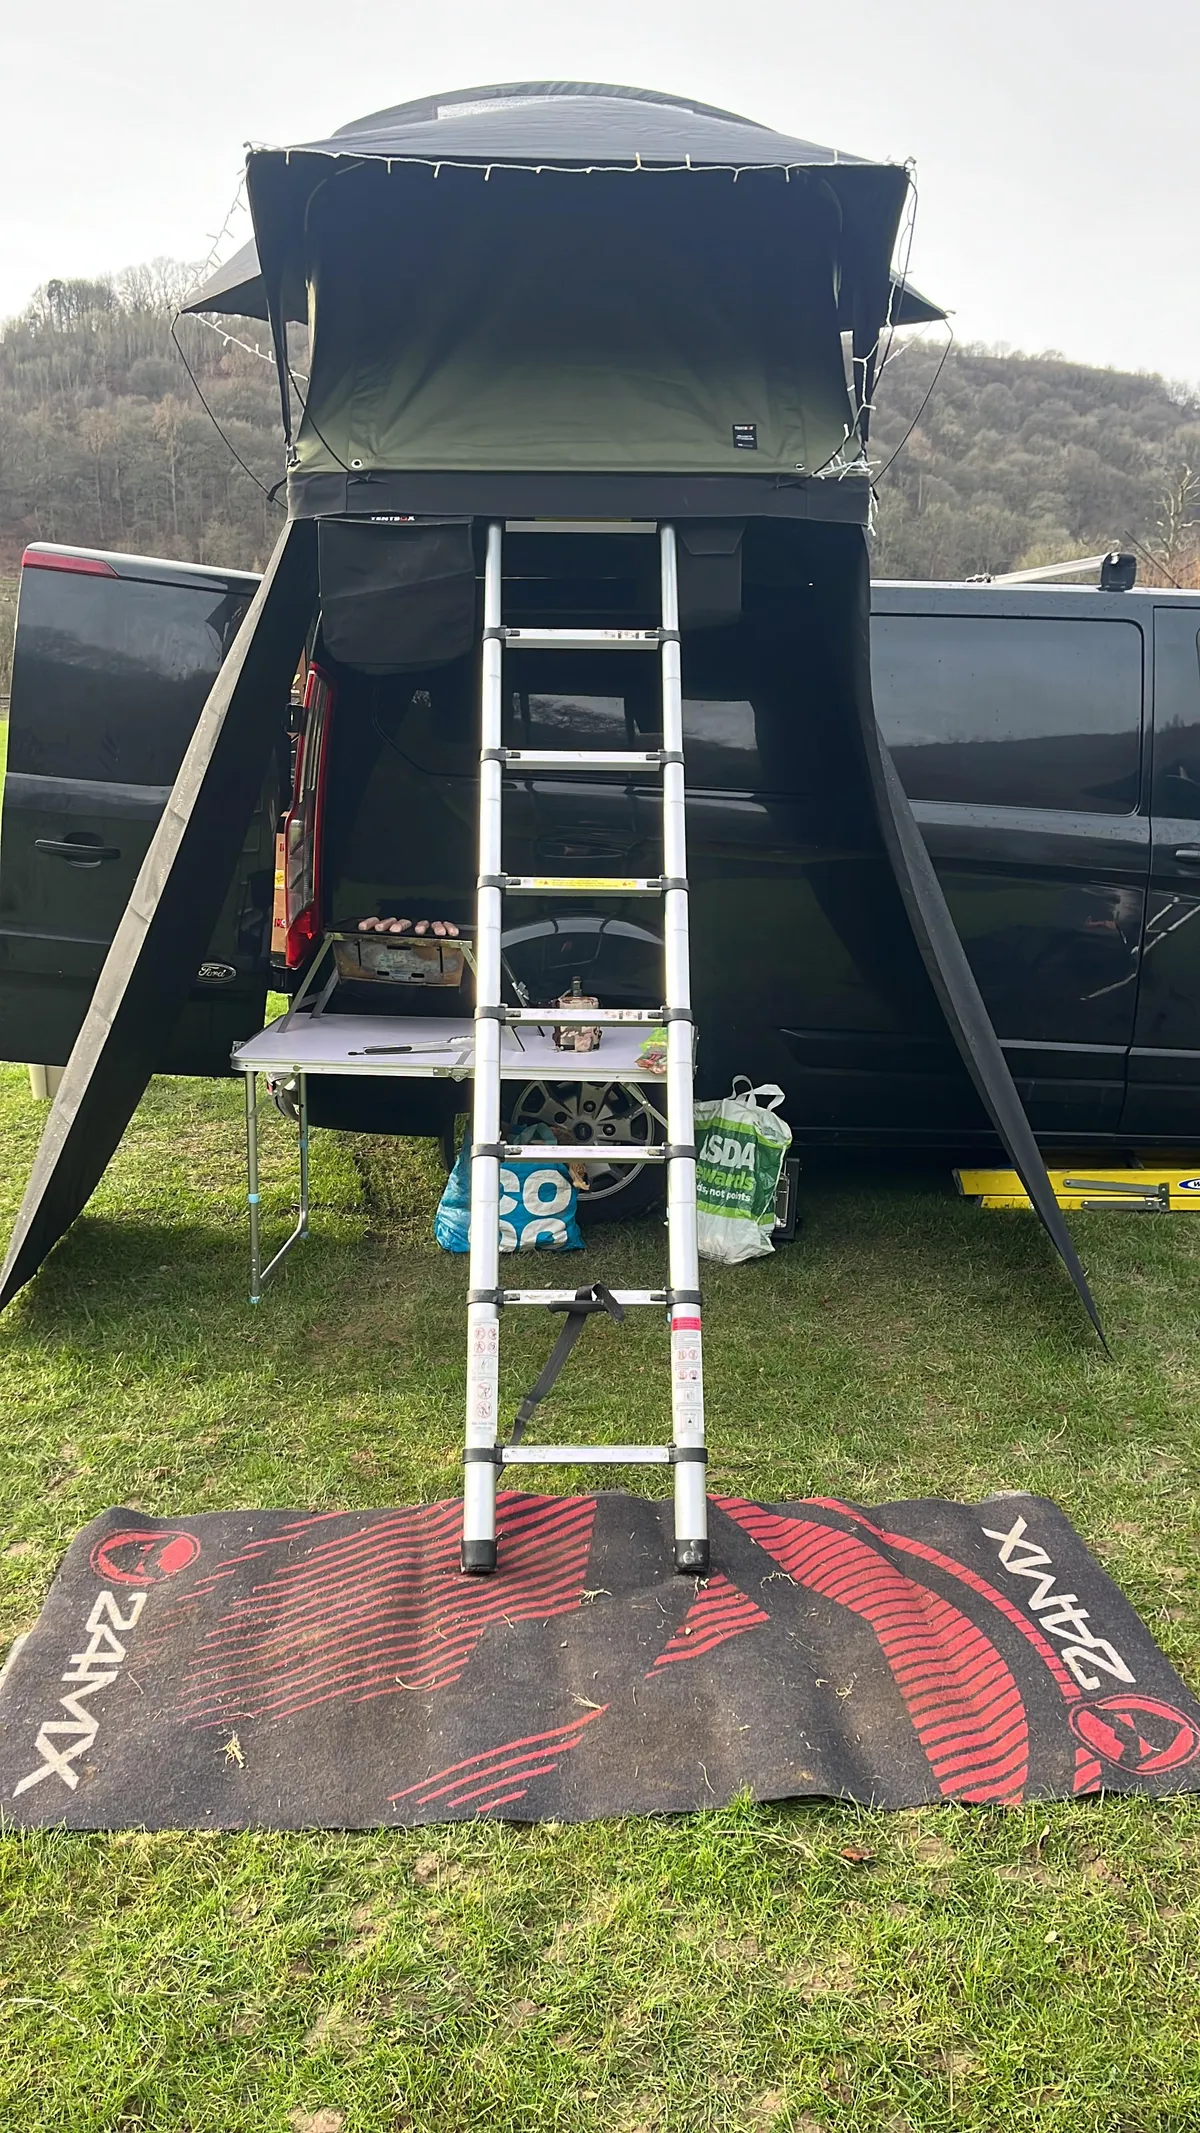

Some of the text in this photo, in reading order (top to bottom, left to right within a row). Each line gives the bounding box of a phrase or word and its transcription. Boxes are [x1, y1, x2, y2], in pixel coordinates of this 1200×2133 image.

[198, 966, 227, 978] Ford
[696, 1165, 756, 1191] ewards
[696, 1181, 752, 1202] ds, not points
[981, 1515, 1137, 1691] 24MX
[12, 1590, 148, 1799] 24MX
